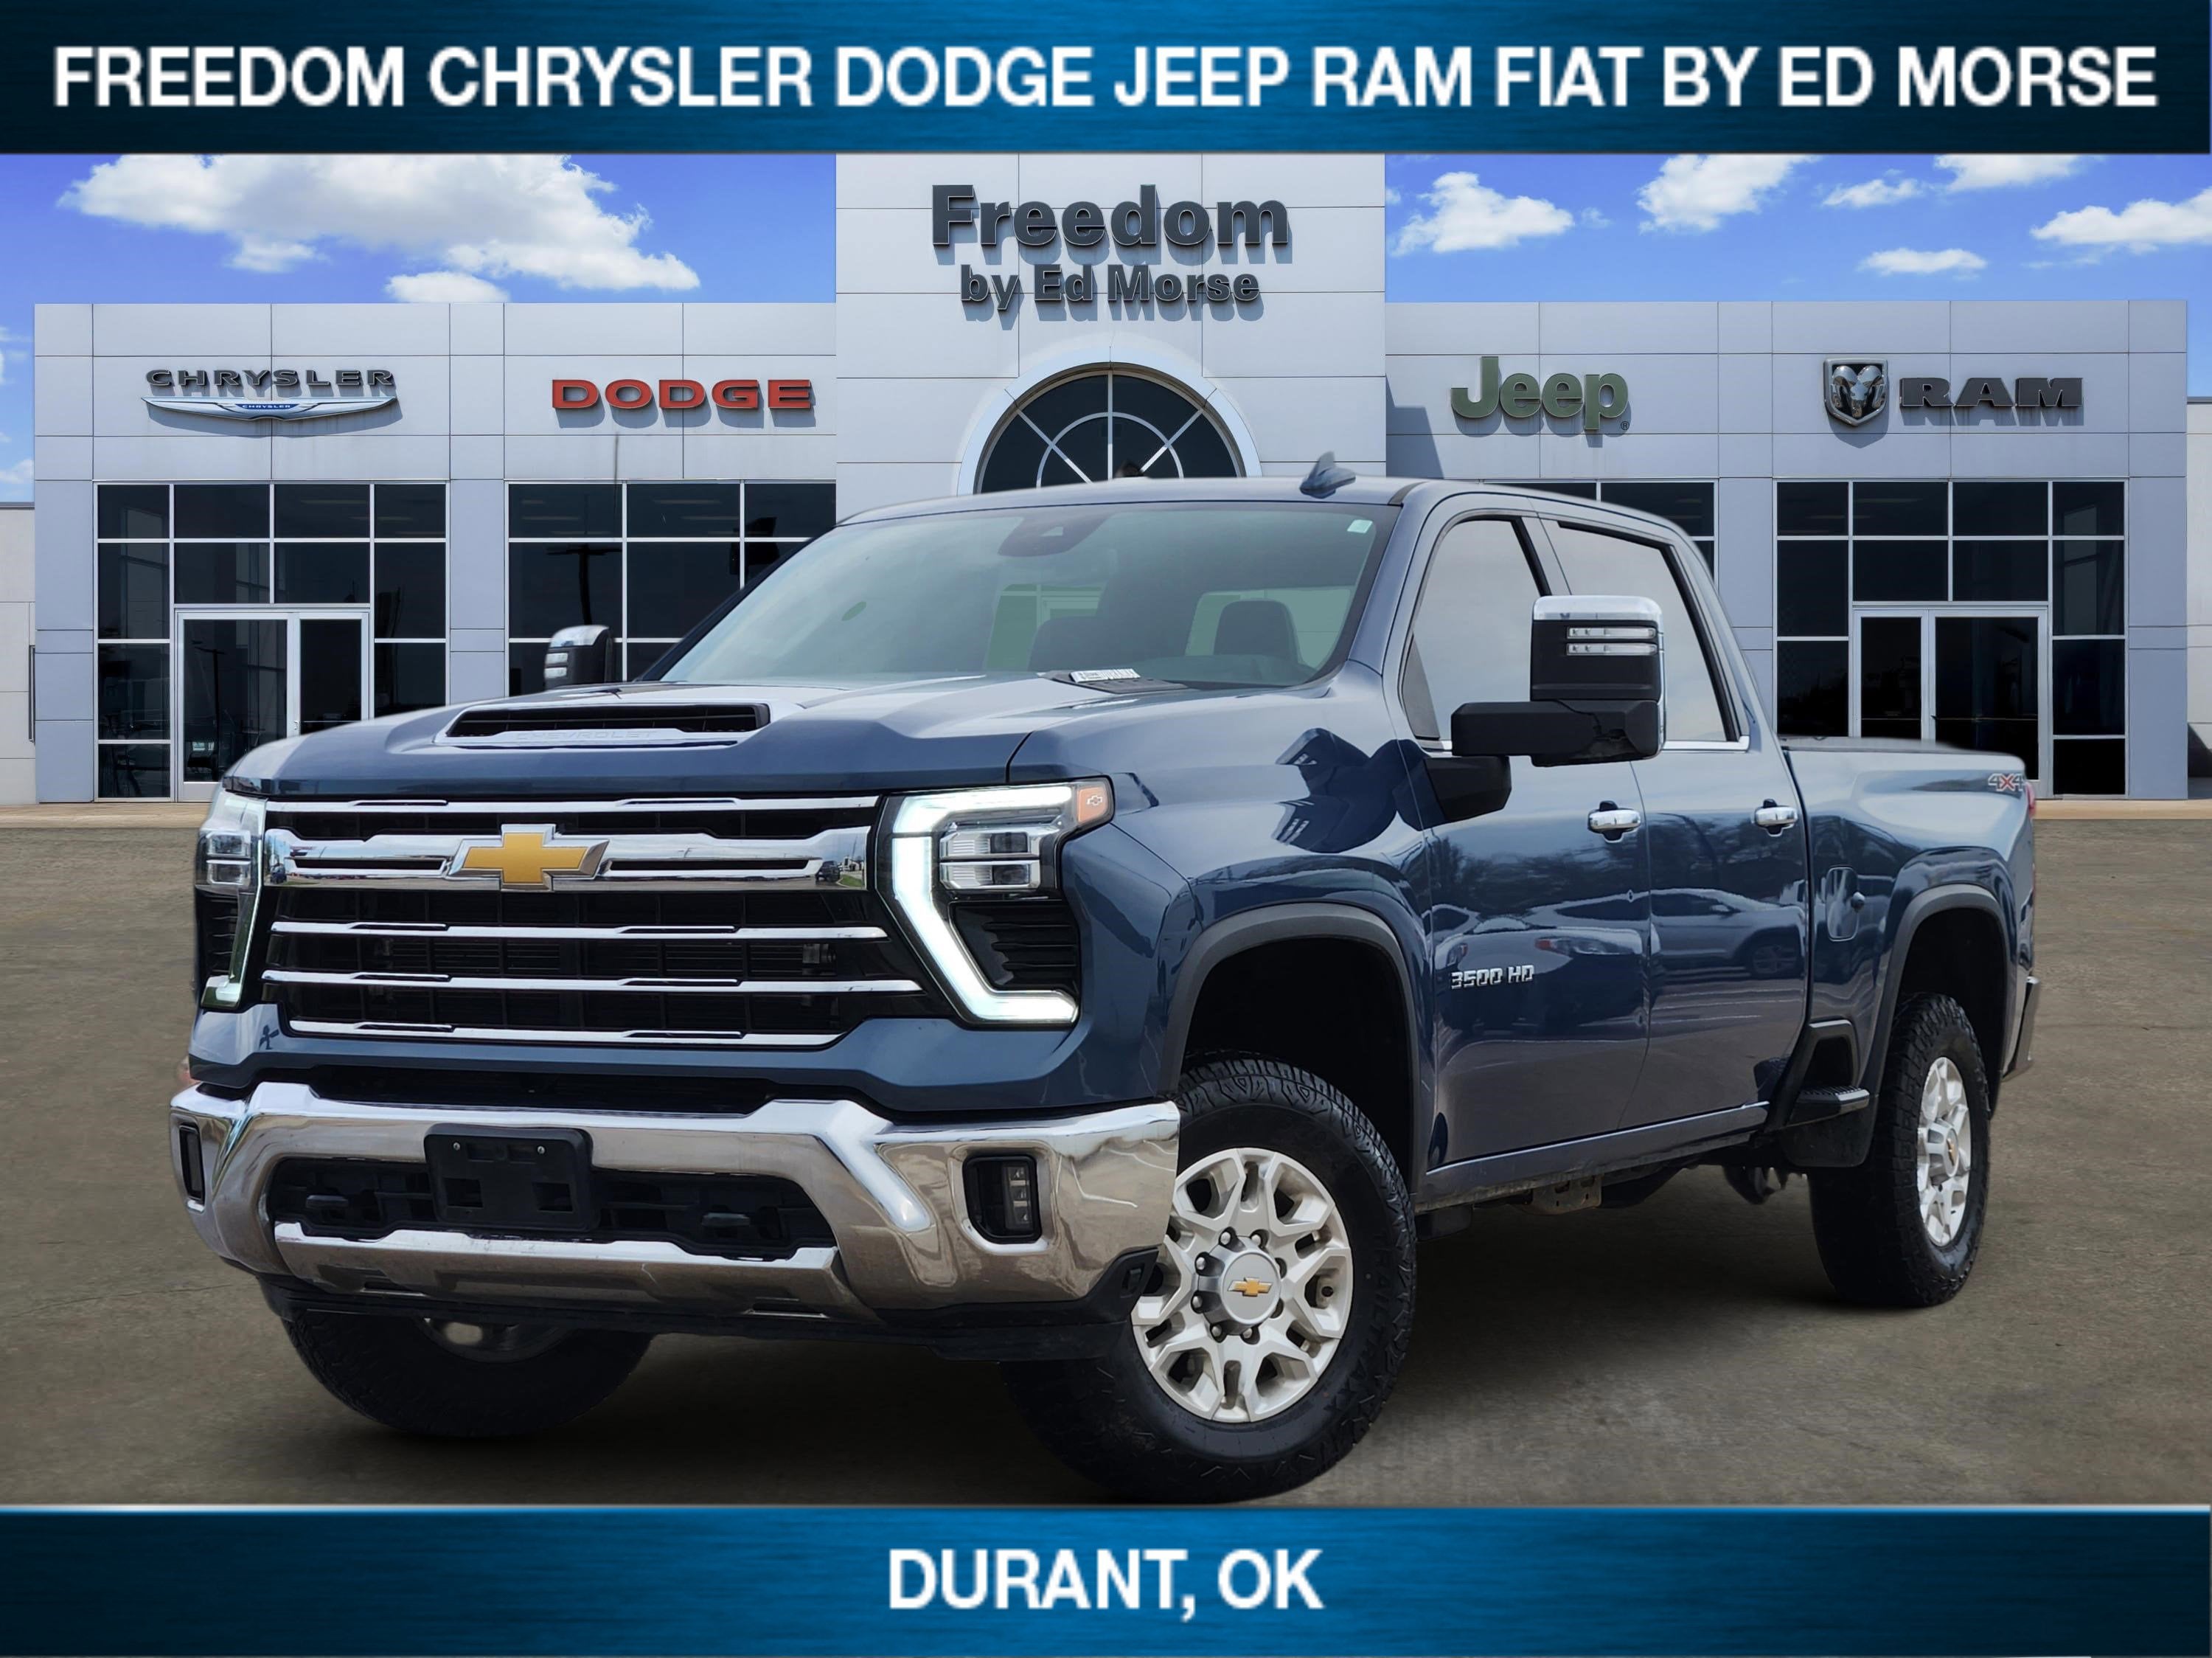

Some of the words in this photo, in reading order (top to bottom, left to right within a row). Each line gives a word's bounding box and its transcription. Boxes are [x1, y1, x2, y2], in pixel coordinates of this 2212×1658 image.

[931, 184, 1289, 246] Freedom
[961, 263, 1019, 311] by
[1034, 263, 1093, 302] Ed
[1107, 263, 1261, 302] Morse
[145, 369, 394, 387] CHRYSLER
[552, 378, 811, 409] DODGE
[1450, 355, 1629, 431] Jeep
[1899, 377, 2084, 408] RAM
[1451, 968, 1503, 990] 3500
[1508, 965, 1534, 984] HD
